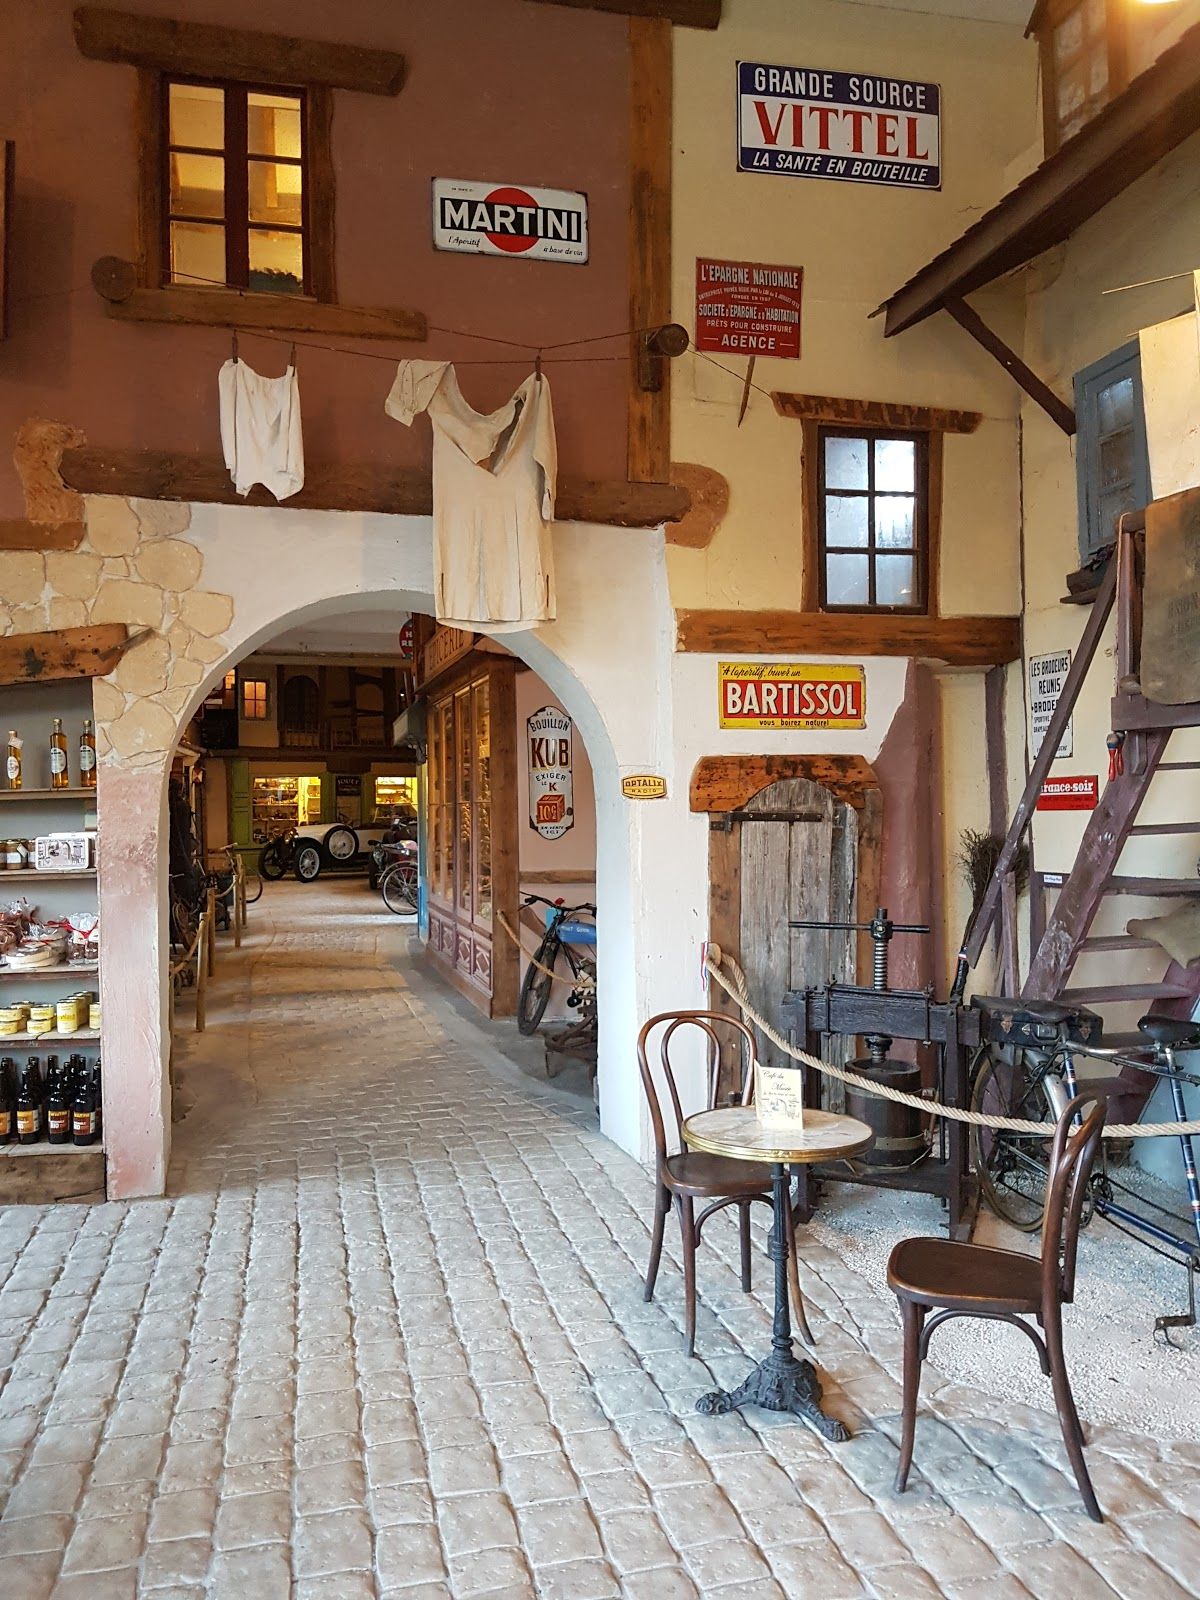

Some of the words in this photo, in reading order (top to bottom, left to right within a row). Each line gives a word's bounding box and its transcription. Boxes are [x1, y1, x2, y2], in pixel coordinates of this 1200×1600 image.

[754, 67, 834, 98] GRANDE
[849, 77, 926, 110] SOURCE
[752, 101, 929, 160] VITTEL
[753, 151, 770, 167] LA
[776, 154, 822, 172] SANTÉ
[826, 158, 847, 174] EN
[851, 161, 929, 182] BOUTEILLE
[444, 199, 578, 241] MARTINI
[752, 268, 799, 289] NATIONALE
[706, 318, 728, 328] PRÊTS
[730, 320, 749, 329] POUR
[751, 322, 793, 333] CONSTRUIRE
[721, 333, 776, 350] AGENCE
[1031, 662, 1040, 678] LES
[1041, 657, 1068, 676] BRODEURS
[727, 682, 857, 715] BARTISSOL
[529, 718, 570, 732] BOUILLON
[805, 719, 829, 727] naturel
[531, 737, 569, 768] KUB
[535, 773, 567, 782] EXIGER
[549, 782, 557, 791] K
[625, 779, 662, 787] OPTALIX
